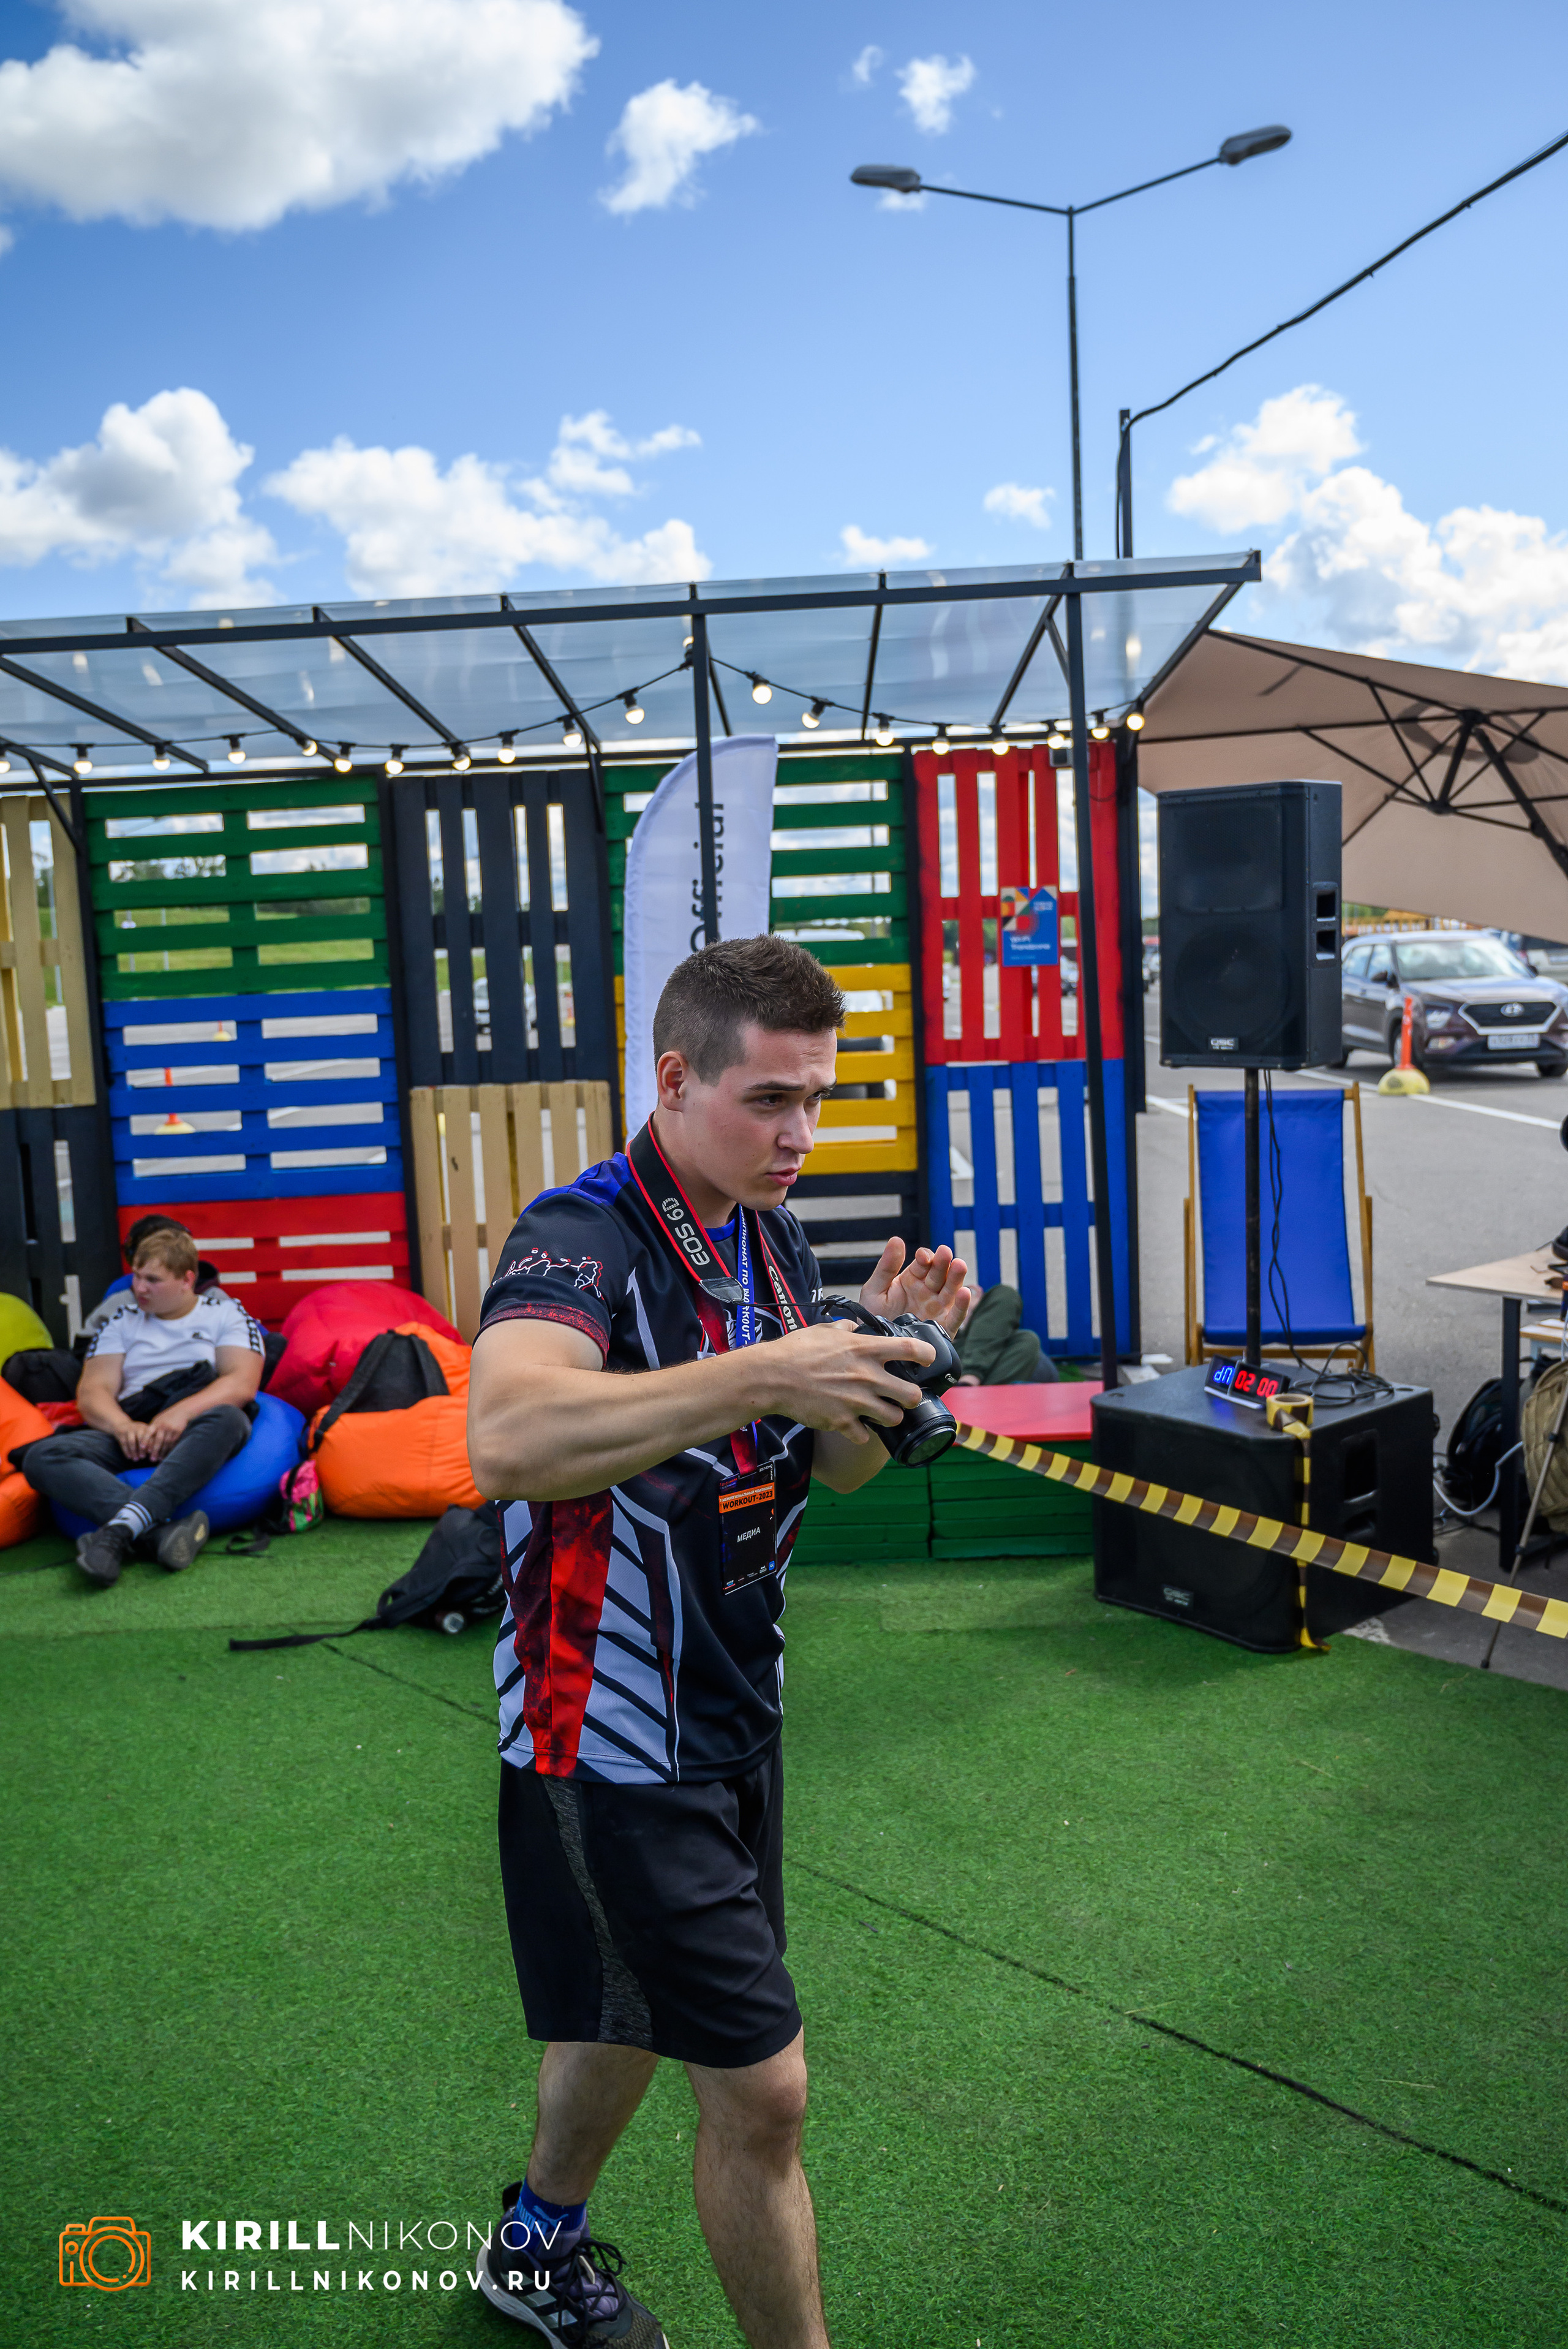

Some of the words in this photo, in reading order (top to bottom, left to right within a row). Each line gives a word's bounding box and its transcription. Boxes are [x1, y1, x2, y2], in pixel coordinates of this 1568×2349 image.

[662, 1197, 684, 1220] 6D
[675, 1223, 710, 1266] EOS
[742, 1269, 749, 1285] ПО
[769, 1265, 798, 1330] Canon
[722, 1491, 773, 1510] WORKOUT-2023
[737, 1526, 761, 1543] МЕДИА
